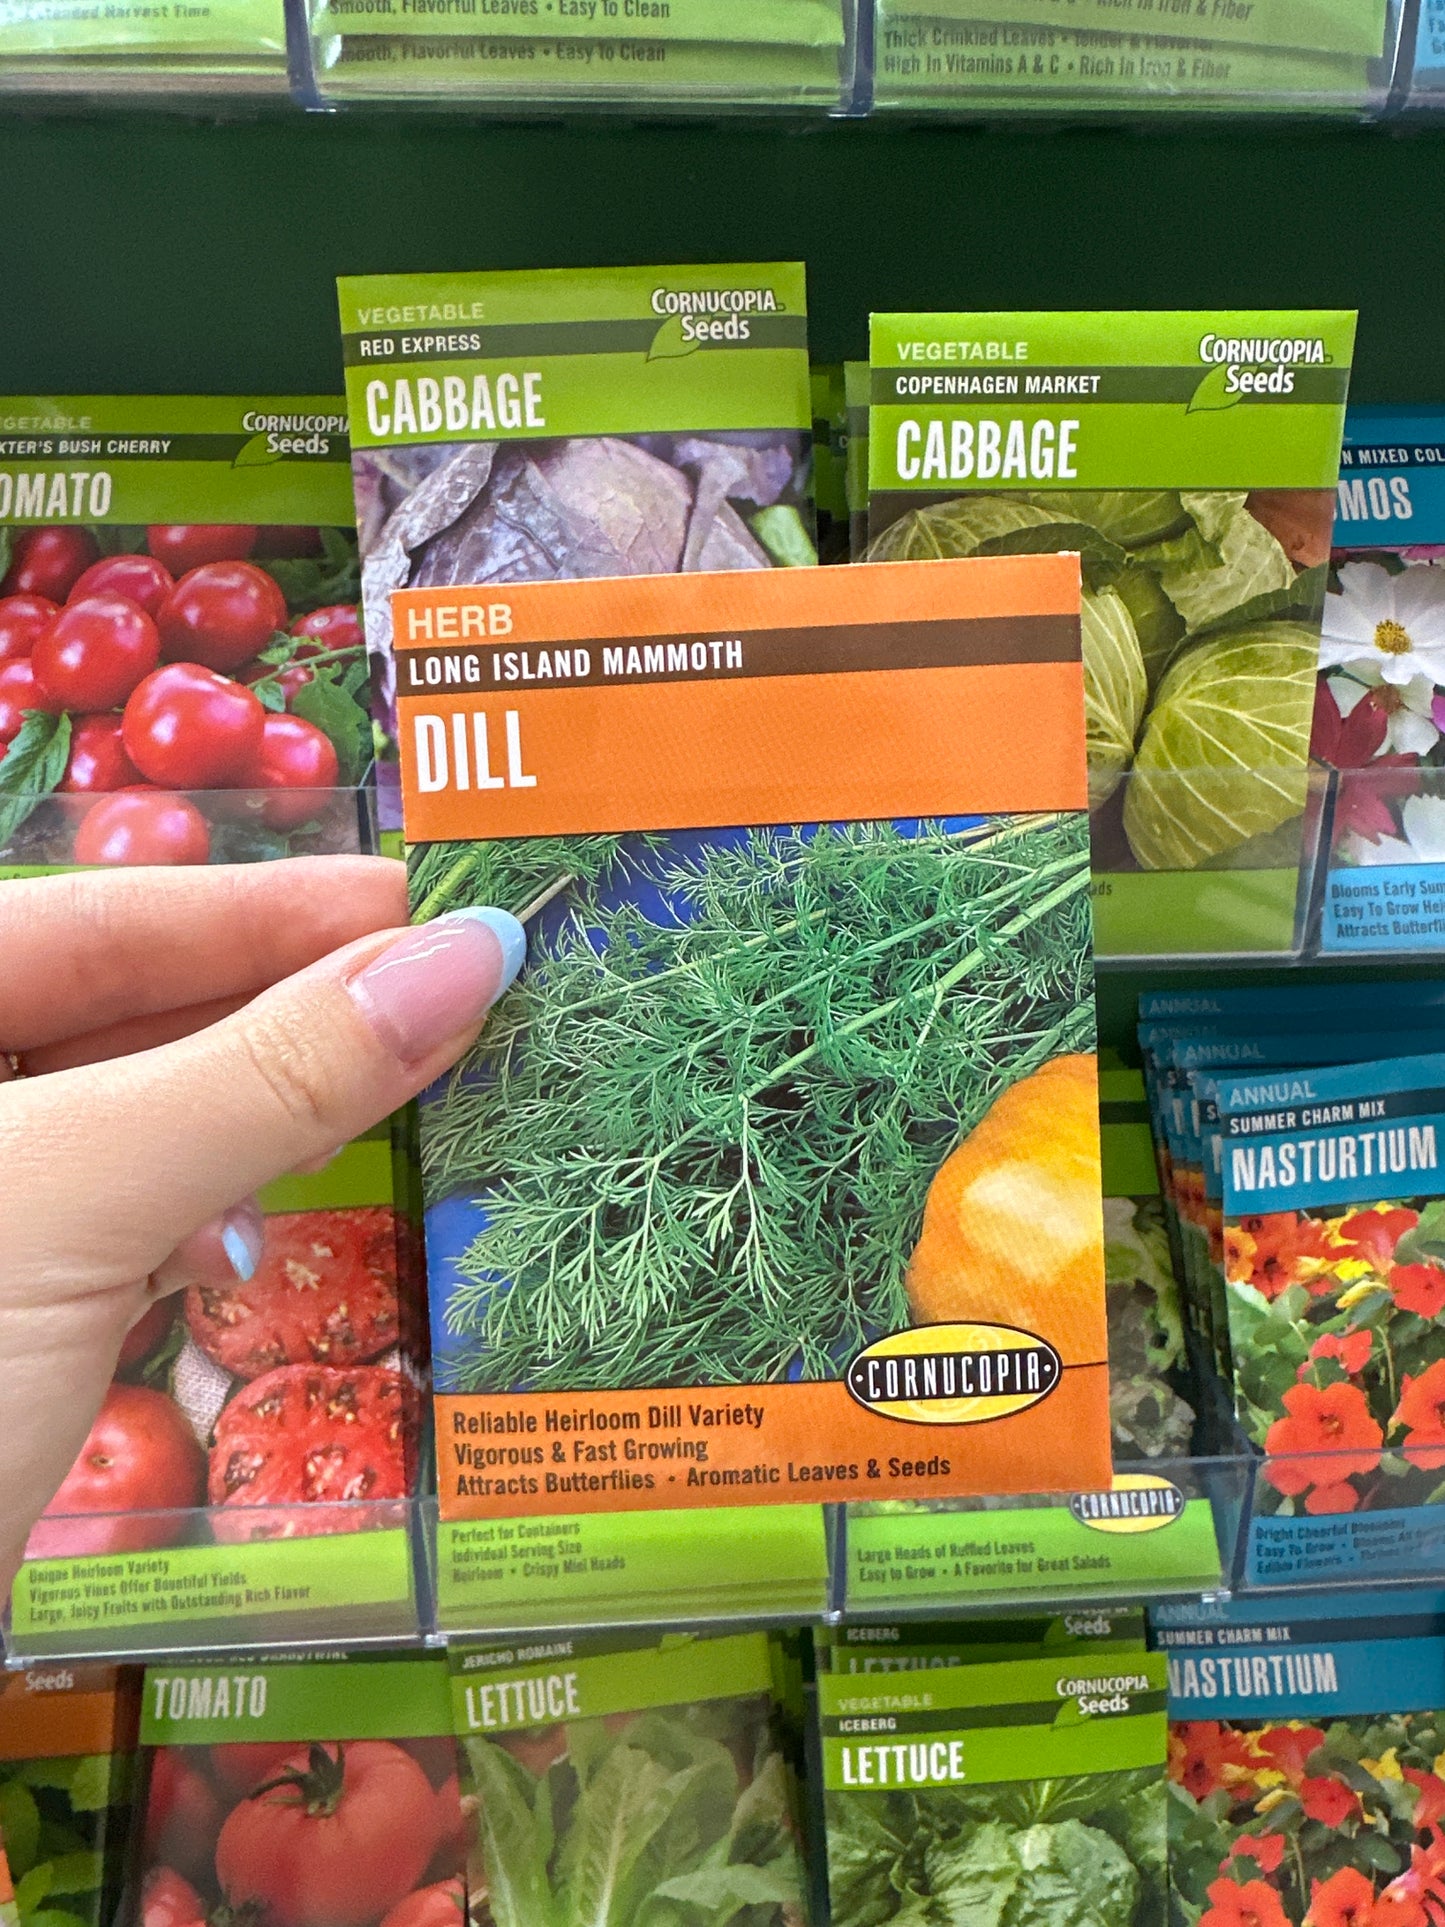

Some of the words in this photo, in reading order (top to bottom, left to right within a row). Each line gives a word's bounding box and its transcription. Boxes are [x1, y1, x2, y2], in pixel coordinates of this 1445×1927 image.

[174, 5, 210, 17] Time
[482, 0, 538, 14] Leaves
[559, 0, 596, 19] Easy
[624, 0, 671, 17] Clean
[1212, 0, 1251, 21] Fiber
[884, 27, 927, 48] Thick
[1003, 29, 1056, 47] Leaves
[481, 43, 535, 60] Leaves
[557, 42, 592, 64] Easy
[620, 42, 667, 61] Clean
[884, 54, 921, 74] High
[926, 55, 941, 72] In
[946, 53, 1014, 73] Vitamins
[1018, 54, 1028, 73] A
[1032, 54, 1044, 74] &
[1050, 54, 1060, 74] C
[1080, 55, 1115, 76] Rich
[1120, 56, 1135, 75] In
[1192, 58, 1232, 78] Fiber
[650, 288, 777, 315] CORNUCOPIA
[357, 302, 485, 325] VEGETABLE
[681, 314, 751, 342] Seeds
[360, 337, 395, 357] RED
[401, 334, 482, 355] EXPRESS
[896, 341, 1029, 361] VEGETABLE
[1199, 334, 1326, 364] CORNUCOPIA
[895, 376, 1019, 396] COPENHAGEN
[1025, 375, 1102, 395] MARKET
[1225, 364, 1295, 394] Seeds
[366, 372, 546, 437] CABBAGE
[58, 440, 102, 454] BUSH
[107, 440, 172, 454] CHERRY
[266, 433, 330, 454] Seeds
[896, 419, 1080, 481] CABBAGE
[1358, 448, 1410, 465] MIXED
[1333, 477, 1413, 521] MOS
[407, 603, 513, 640] HERB
[409, 653, 481, 686] LONG
[493, 648, 591, 681] ISLAND
[602, 640, 743, 675] MAMMOTH
[413, 709, 537, 793] DILL
[1331, 884, 1380, 898] Blooms
[1383, 881, 1416, 898] Early
[1334, 903, 1364, 920] Easy
[1367, 902, 1383, 916] To
[1386, 901, 1419, 915] Grow
[1337, 922, 1390, 938] Attracts
[1229, 1080, 1317, 1107] ANNUAL
[1230, 1112, 1297, 1135] SUMMER
[1302, 1104, 1354, 1127] CHARM
[1358, 1100, 1386, 1118] MIX
[1232, 1125, 1438, 1192] NASTURTIUM
[868, 1351, 1041, 1399] CORNUCOPIA
[453, 1411, 537, 1434] Reliable
[545, 1408, 641, 1432] Heirloom
[648, 1405, 682, 1428] Dill
[689, 1403, 765, 1429] Variety
[453, 1443, 544, 1470] Vigorous
[551, 1441, 566, 1463] &
[574, 1439, 617, 1463] Fast
[624, 1436, 708, 1462] Growing
[456, 1473, 539, 1496] Attracts
[545, 1468, 656, 1493] Butterflies
[687, 1464, 780, 1488] Aromatic
[788, 1459, 864, 1482] Leaves
[867, 1457, 882, 1479] &
[888, 1454, 952, 1479] Seeds
[452, 1528, 494, 1543] Perfect
[518, 1522, 580, 1539] Containers
[511, 1542, 555, 1559] Serving
[858, 1548, 891, 1564] Large
[994, 1541, 1035, 1555] Leaves
[127, 1560, 170, 1575] Variety
[523, 1562, 560, 1578] Crispy
[859, 1567, 887, 1583] Easy
[905, 1566, 936, 1579] Grow
[954, 1563, 962, 1577] A
[1037, 1557, 1069, 1572] Great
[245, 1588, 271, 1603] Rich
[847, 1627, 900, 1642] ICEBERG
[1064, 1615, 1112, 1636] Seeds
[1157, 1630, 1214, 1646] SUMMER
[1217, 1627, 1263, 1644] CHARM
[1266, 1626, 1291, 1642] MIX
[462, 1649, 514, 1669] JERICHO
[517, 1641, 574, 1661] ROMAINE
[25, 1668, 75, 1692] Seeds
[1056, 1675, 1149, 1697] CORNUCOPIA
[154, 1676, 268, 1720] TOMATO
[465, 1672, 581, 1729] LETTUCE
[1078, 1695, 1130, 1716] Seeds
[839, 1717, 897, 1732] ICEBERG
[842, 1740, 965, 1785] LETTUCE
